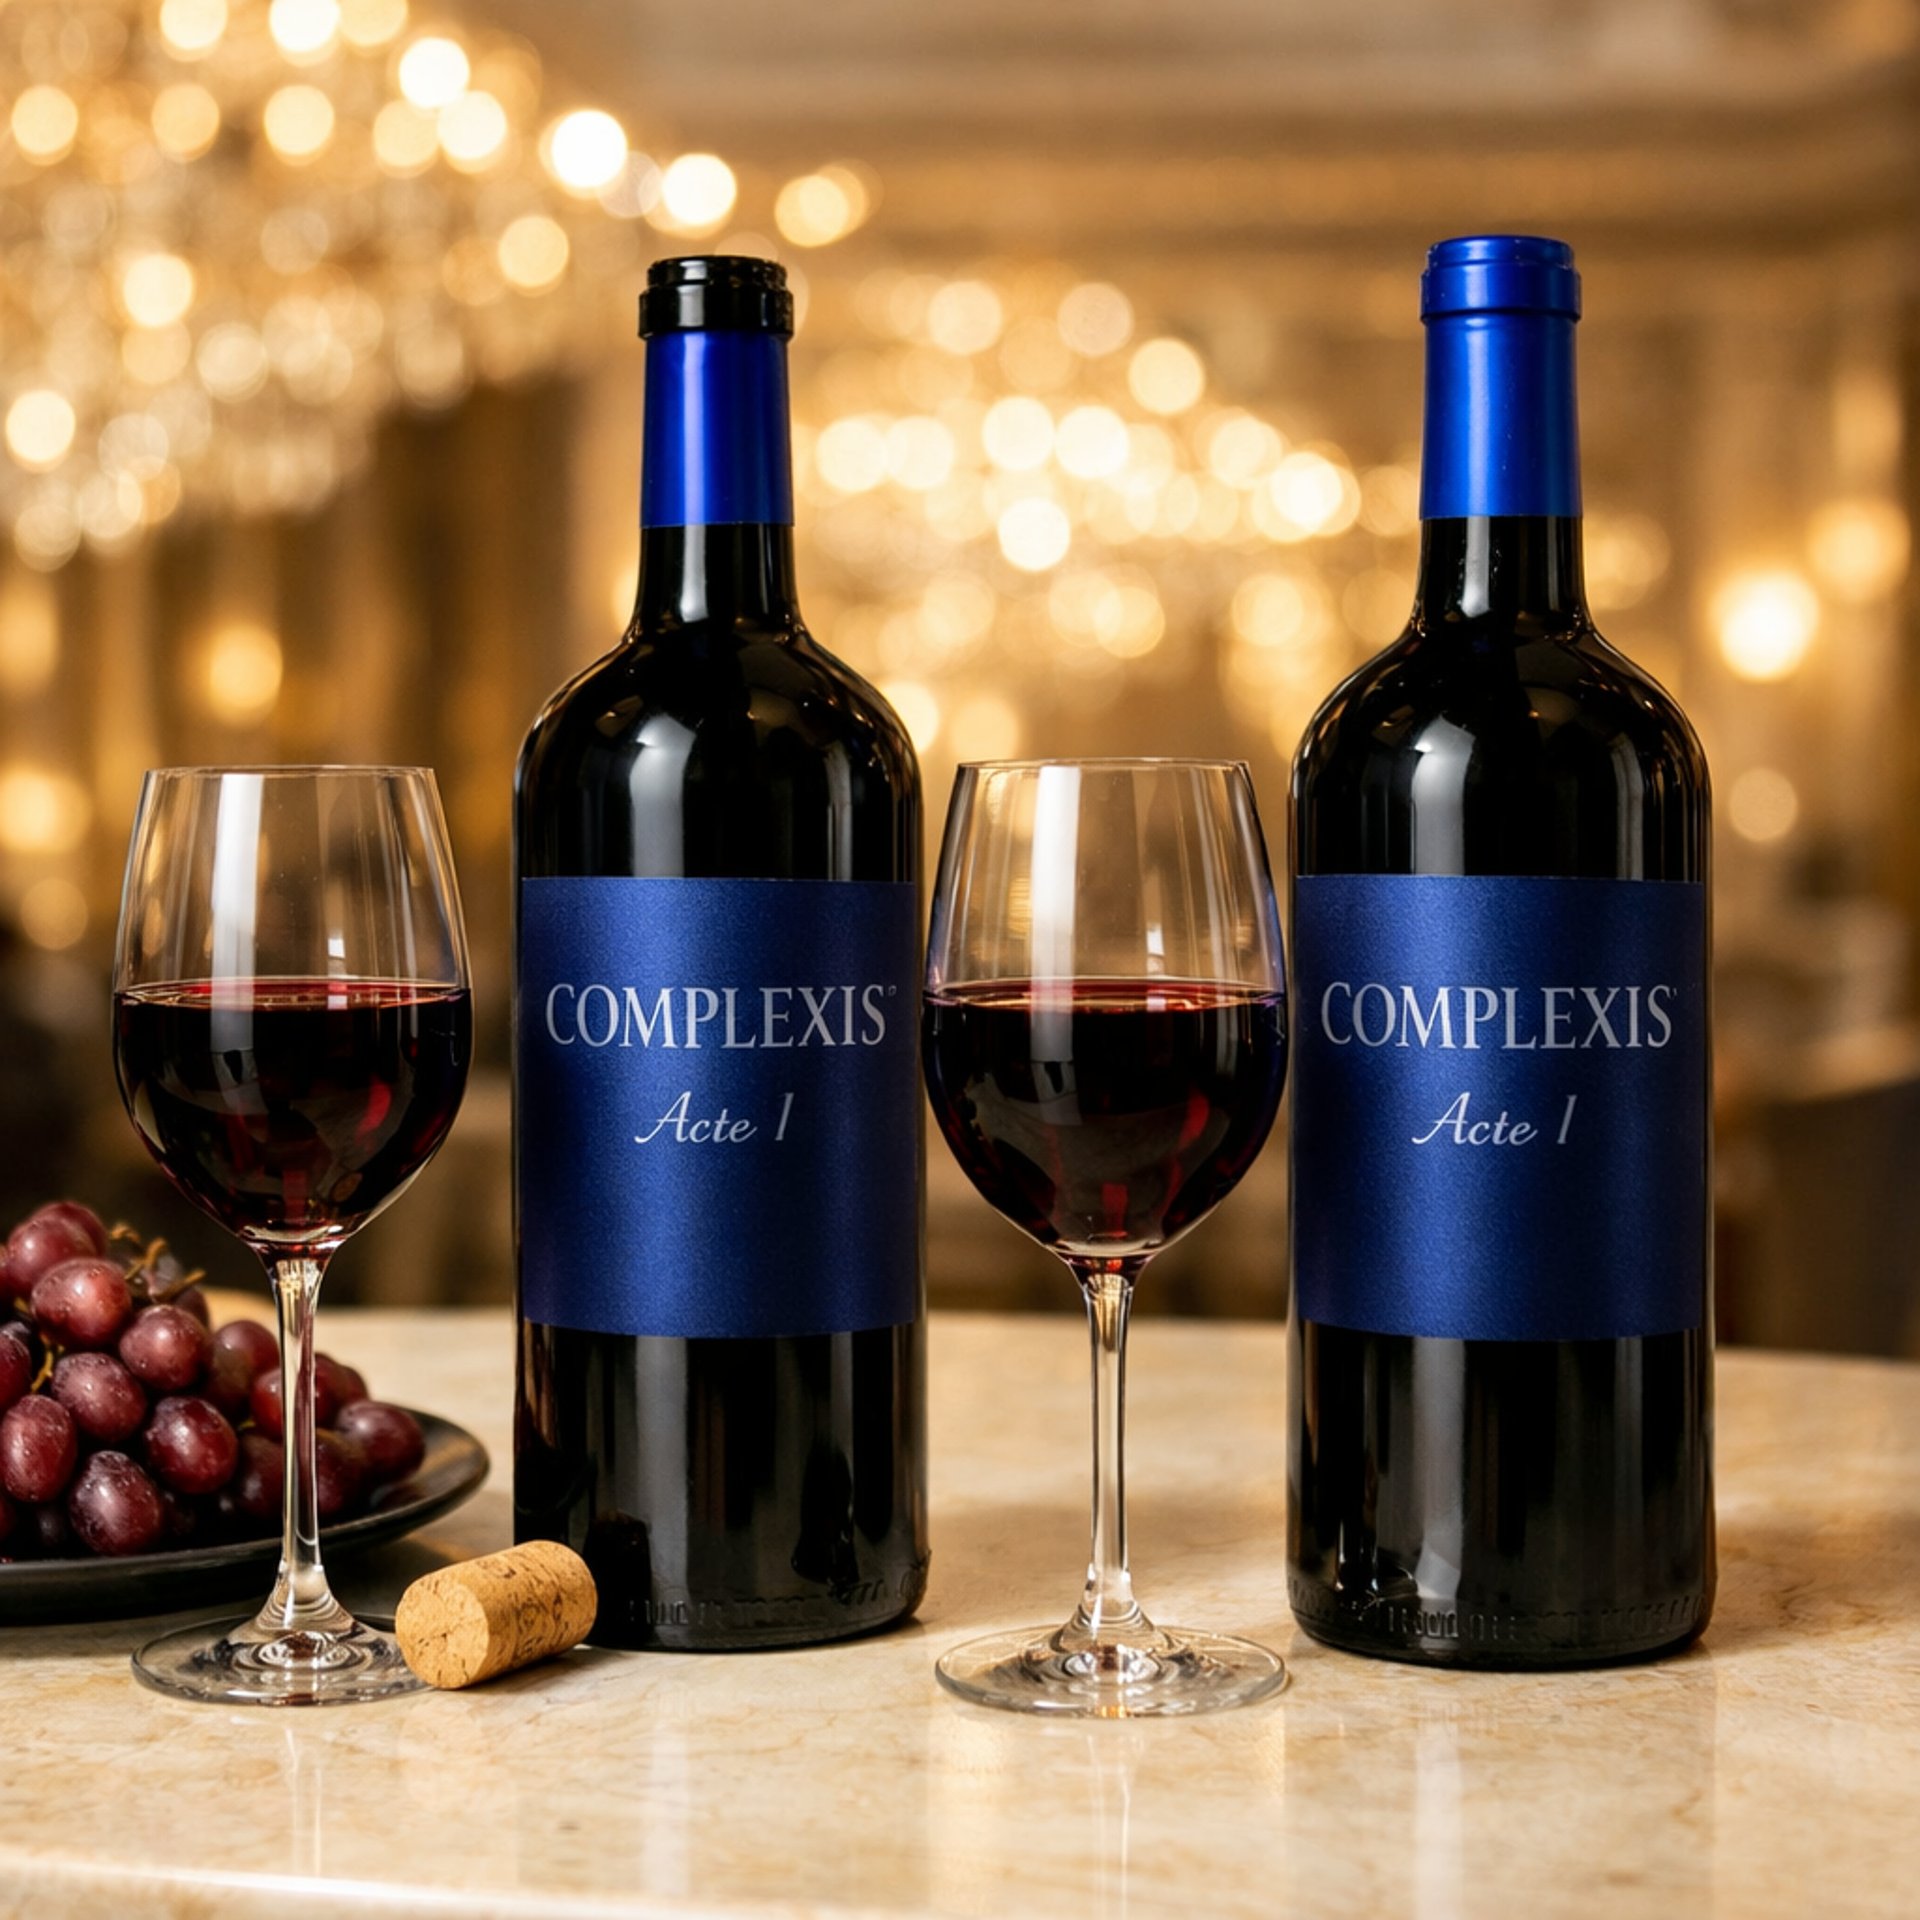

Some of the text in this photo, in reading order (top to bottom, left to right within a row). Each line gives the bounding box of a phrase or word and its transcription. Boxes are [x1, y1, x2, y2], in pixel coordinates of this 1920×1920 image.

[545, 983, 886, 1049] COMPLEXIS
[1321, 981, 1672, 1049] COMPLEXIS
[634, 1090, 758, 1145] Acte
[1411, 1091, 1539, 1146] Acte
